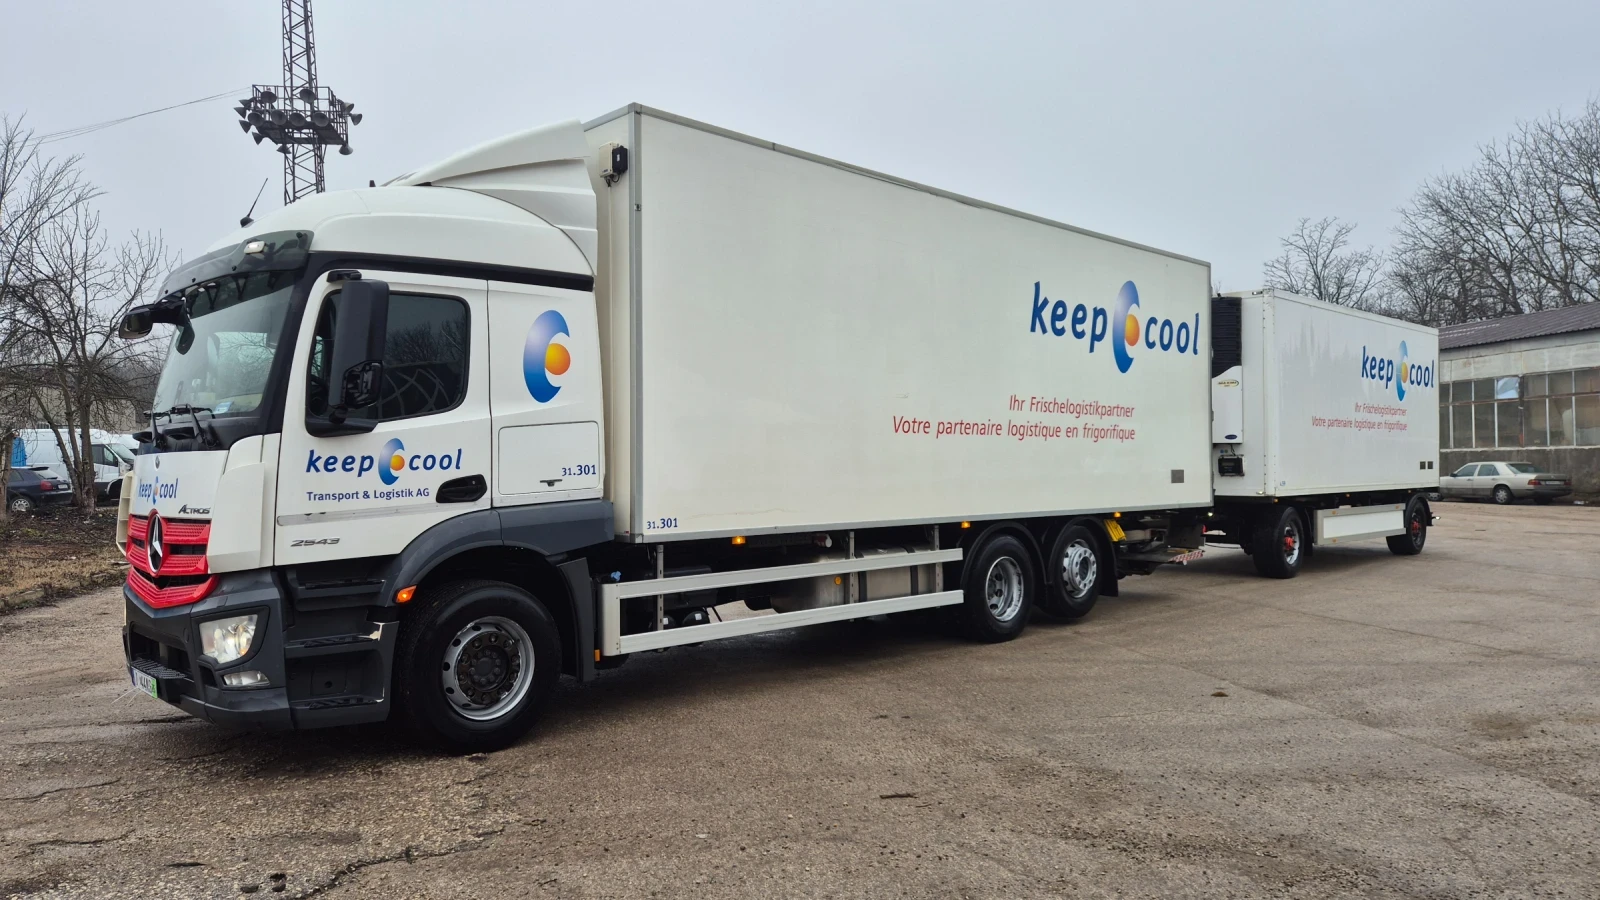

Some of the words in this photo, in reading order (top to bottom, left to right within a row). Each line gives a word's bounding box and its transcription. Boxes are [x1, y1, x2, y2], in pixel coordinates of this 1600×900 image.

[1030, 281, 1108, 353] keep
[1144, 312, 1199, 355] cool
[1361, 345, 1393, 389] keep
[1409, 360, 1434, 388] cool
[1009, 395, 1025, 412] Ihr
[1029, 396, 1135, 419] Frischelogistikpartner
[893, 416, 931, 434] Votre
[936, 419, 1002, 438] partenaire
[1007, 420, 1061, 441] logistique
[1065, 426, 1078, 438] en
[1082, 423, 1135, 443] frigorifique
[1312, 416, 1326, 427] Votre
[1327, 417, 1353, 430] partenaire
[1354, 418, 1376, 431] logistique
[306, 449, 374, 477] keep
[408, 448, 462, 472] cool
[561, 464, 597, 476] 31.301
[138, 479, 152, 503] keep
[159, 477, 178, 498] cool
[306, 491, 359, 502] Transport
[362, 489, 371, 499] &
[373, 488, 414, 500] Logistik
[414, 488, 430, 498] AG
[646, 517, 678, 529] 31.301
[290, 537, 340, 547] 2543
